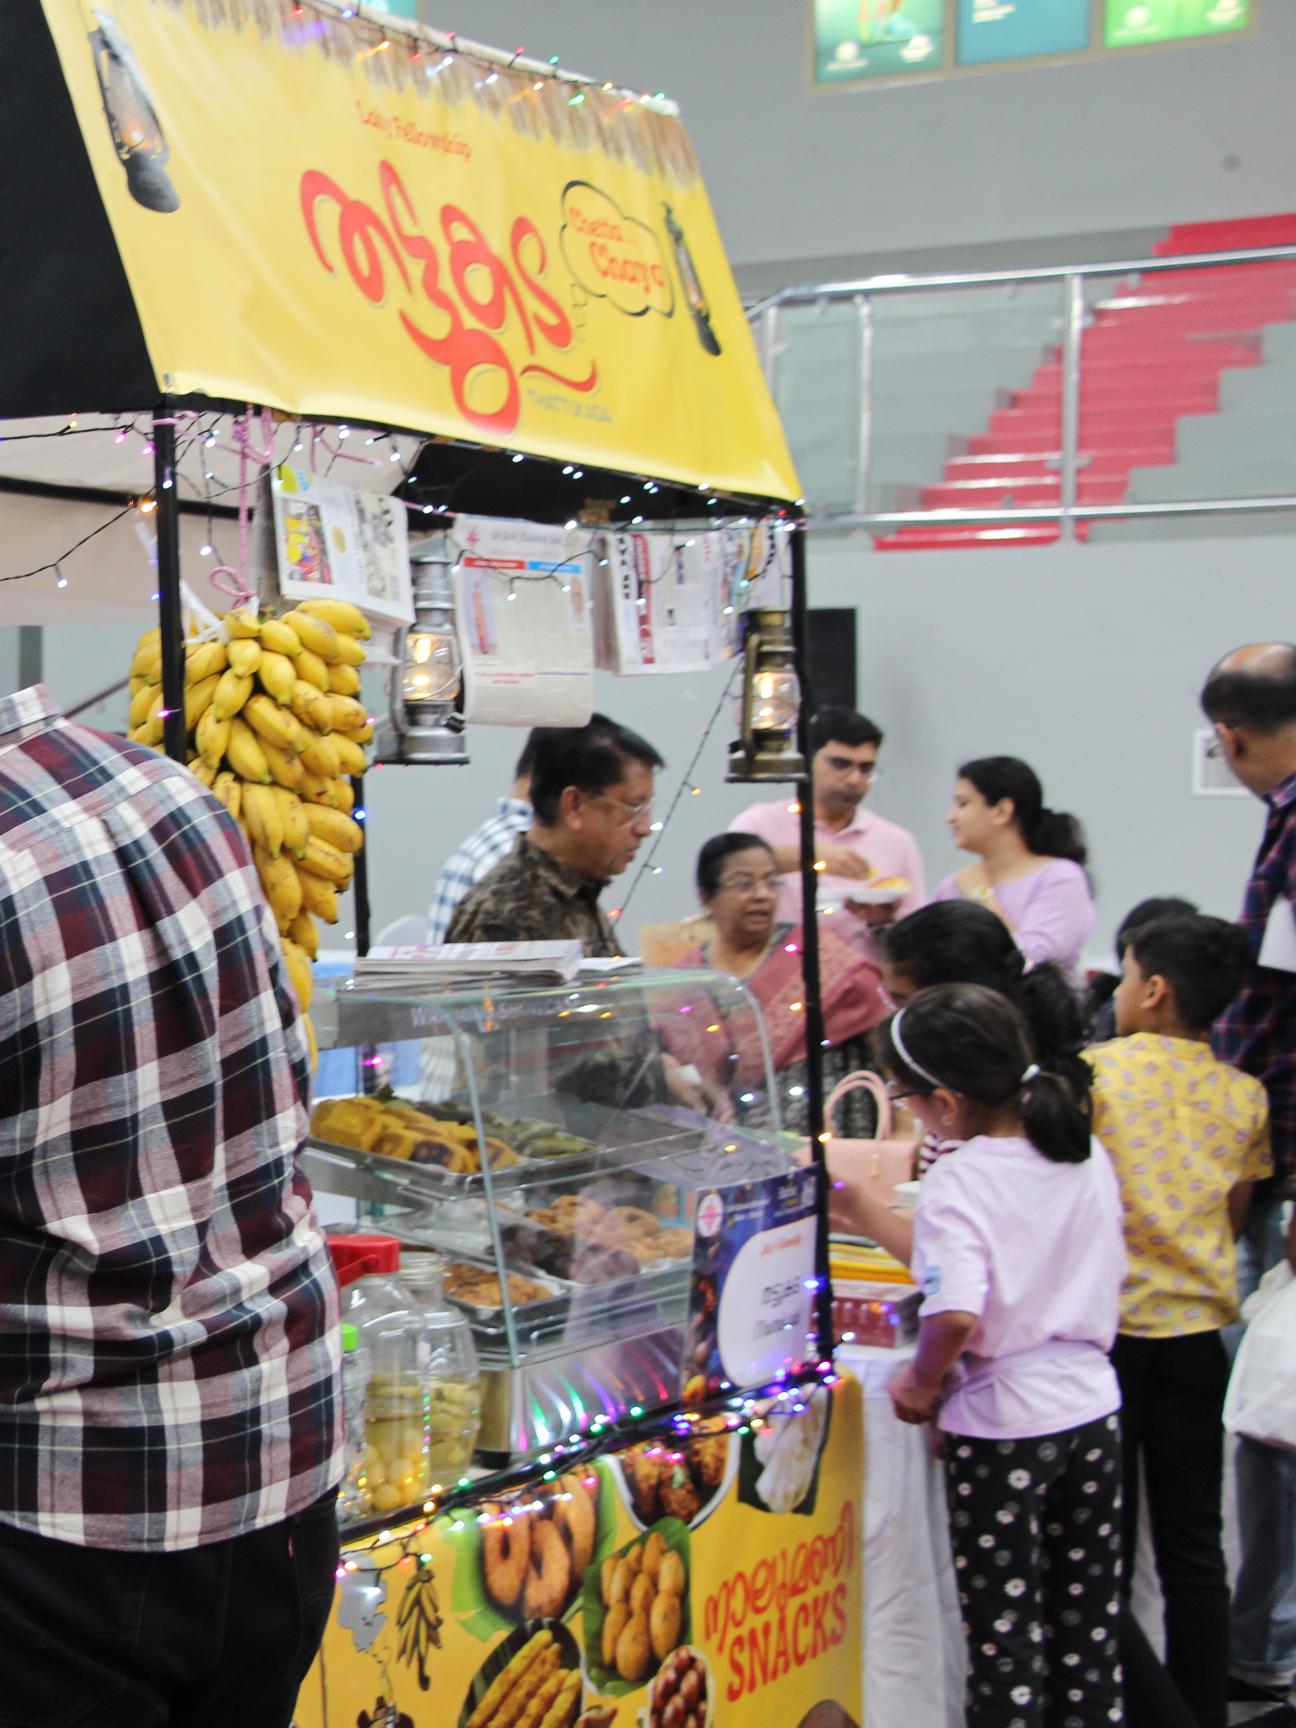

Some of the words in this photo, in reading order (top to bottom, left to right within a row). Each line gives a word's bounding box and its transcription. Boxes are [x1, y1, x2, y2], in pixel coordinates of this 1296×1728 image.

[391, 115, 472, 163] Fellowship
[589, 239, 666, 296] Chaya
[726, 1581, 848, 1703] SNACKS
